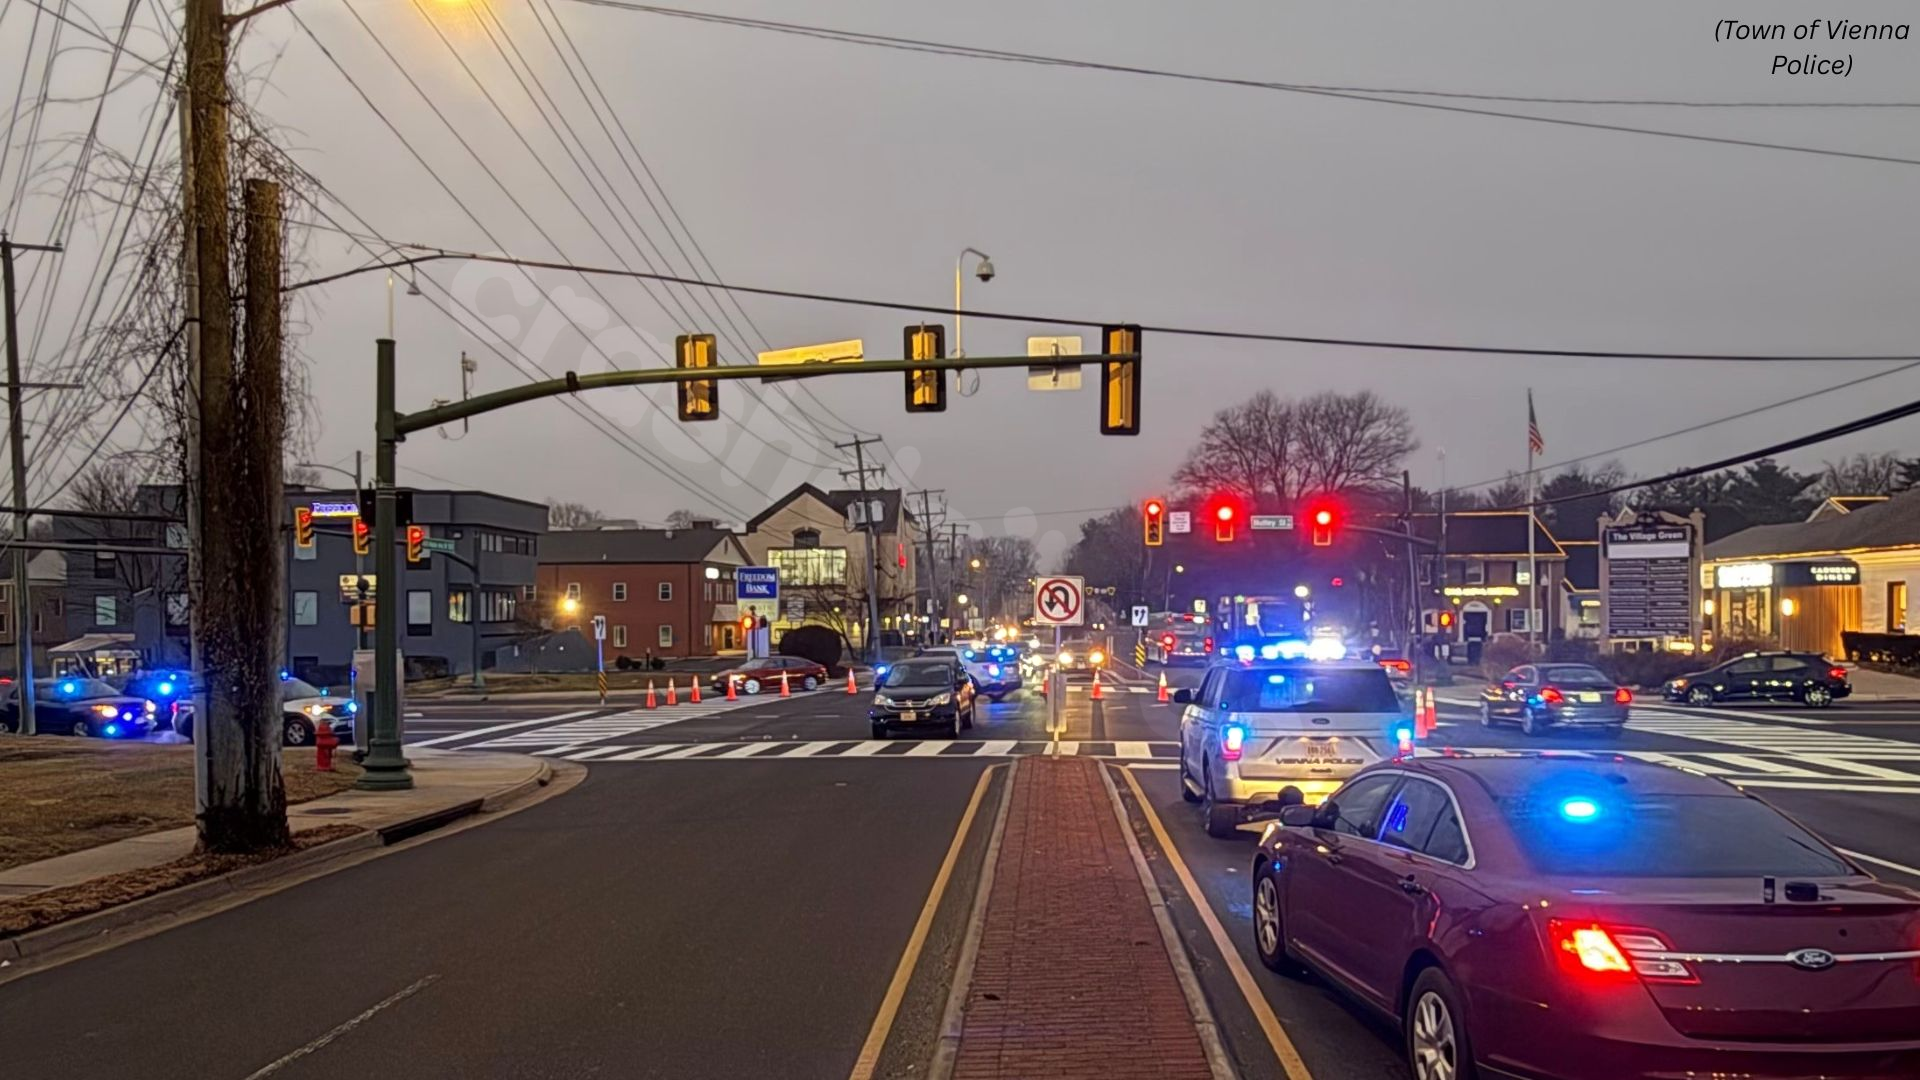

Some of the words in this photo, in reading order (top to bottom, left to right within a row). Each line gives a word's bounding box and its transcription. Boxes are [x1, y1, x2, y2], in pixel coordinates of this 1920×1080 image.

[1612, 533, 1628, 541] The
[1629, 532, 1657, 542] Village
[1658, 531, 1683, 540] Green
[740, 572, 776, 582] FREEDOM
[746, 585, 770, 594] BANK
[1275, 758, 1320, 766] VIENNA
[1323, 758, 1365, 766] POLICE
[1803, 952, 1826, 964] Ford
